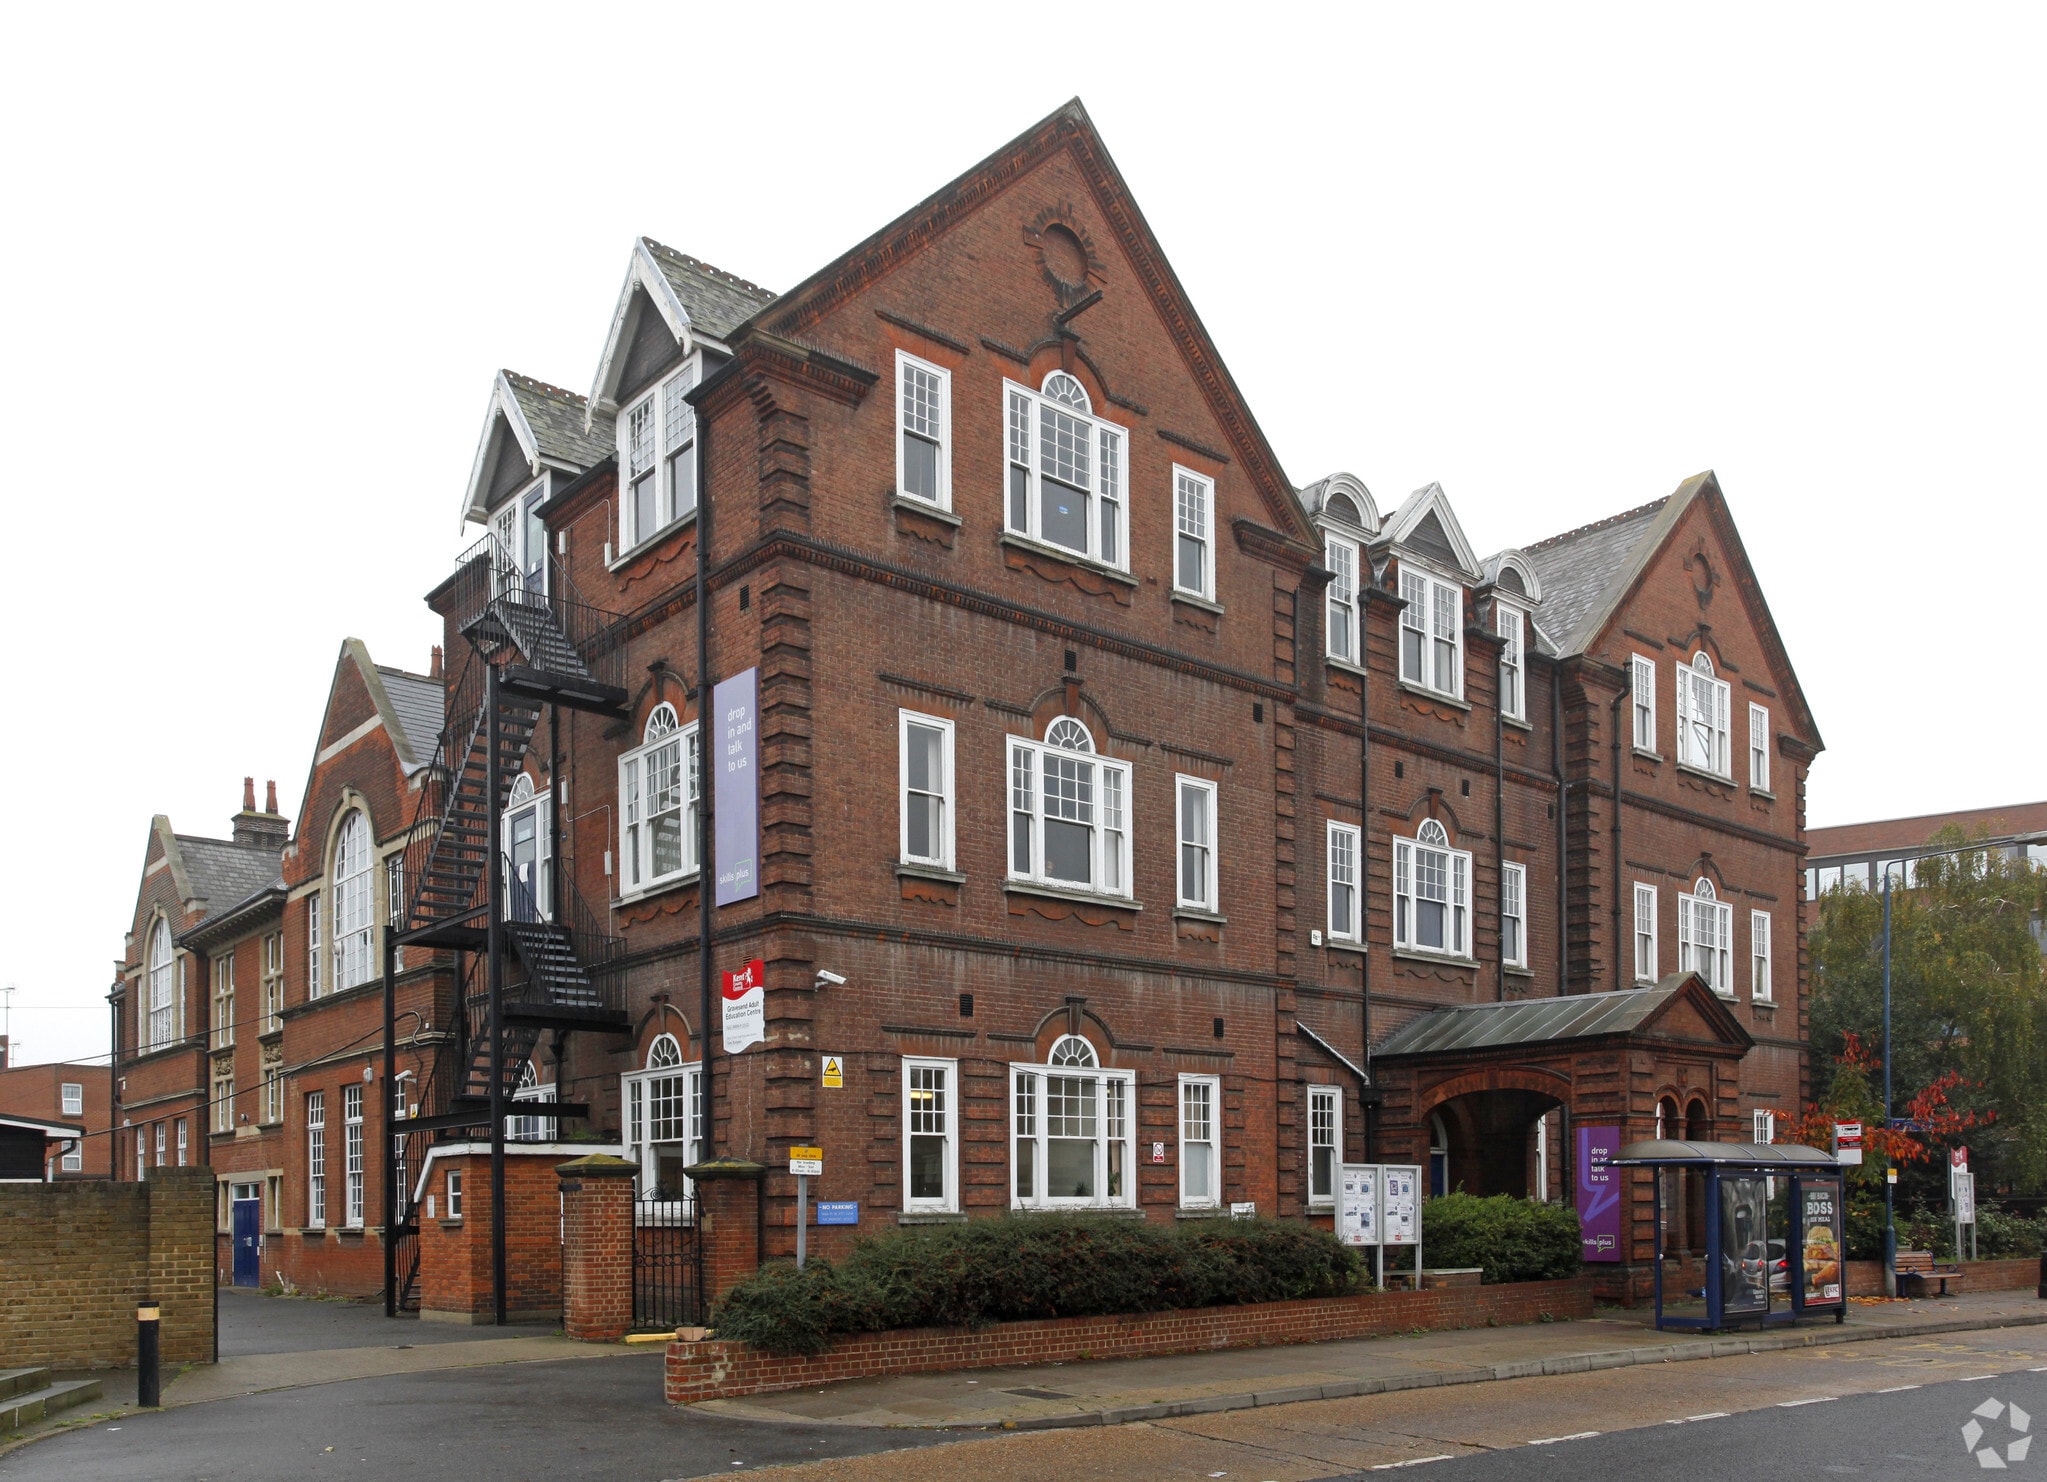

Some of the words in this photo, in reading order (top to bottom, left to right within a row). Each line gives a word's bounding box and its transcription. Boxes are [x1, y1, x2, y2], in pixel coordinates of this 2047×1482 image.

[727, 705, 746, 722] drop
[727, 726, 735, 740] in
[737, 717, 752, 736] and
[727, 739, 743, 755] talk
[727, 760, 736, 773] to
[737, 756, 747, 768] us
[719, 870, 734, 885] skills
[736, 868, 750, 883] plus
[749, 1001, 760, 1009] Adult
[725, 1011, 747, 1020] Education
[747, 1008, 761, 1017] Centre
[1591, 1147, 1608, 1156] drop
[1591, 1165, 1605, 1173] talk
[1806, 1201, 1833, 1215] BOSS
